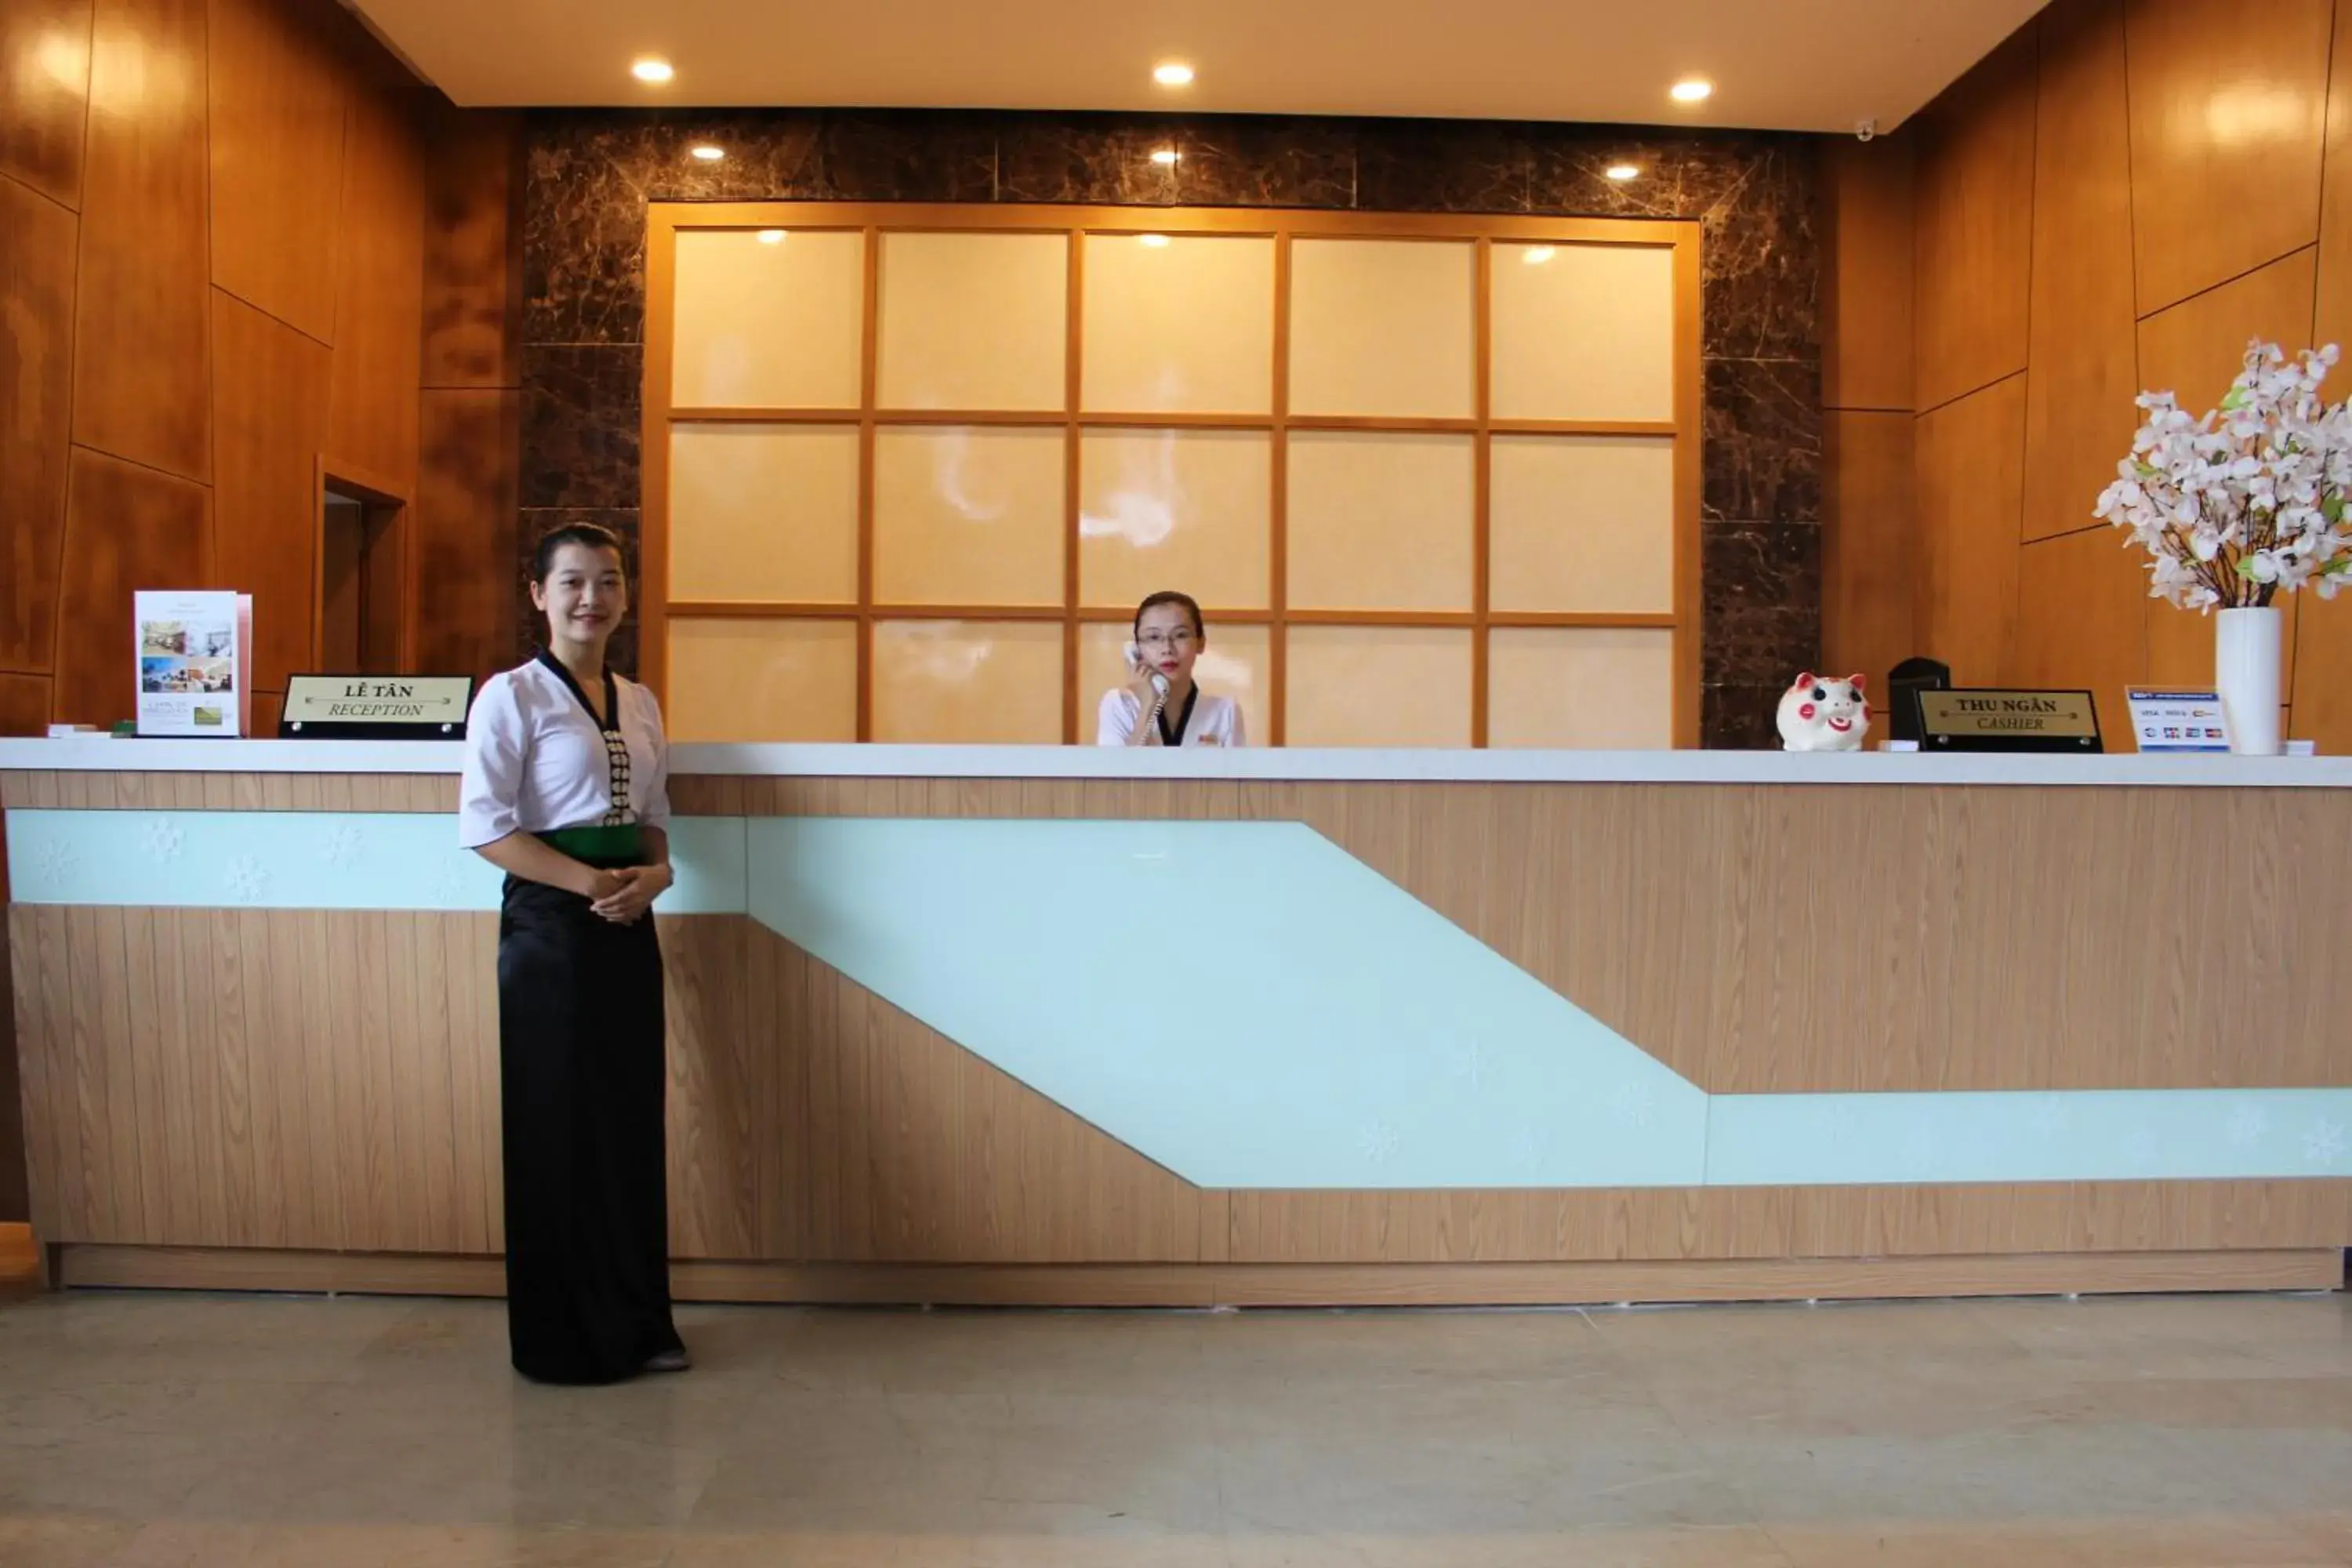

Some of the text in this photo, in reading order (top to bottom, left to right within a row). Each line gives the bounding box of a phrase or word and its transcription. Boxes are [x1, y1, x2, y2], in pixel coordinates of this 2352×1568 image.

[344, 681, 414, 697] LÊ TÂN
[328, 703, 424, 716] RECEPTION
[1955, 697, 2057, 712] THU NGÂN
[1976, 717, 2045, 730] CASHIER
